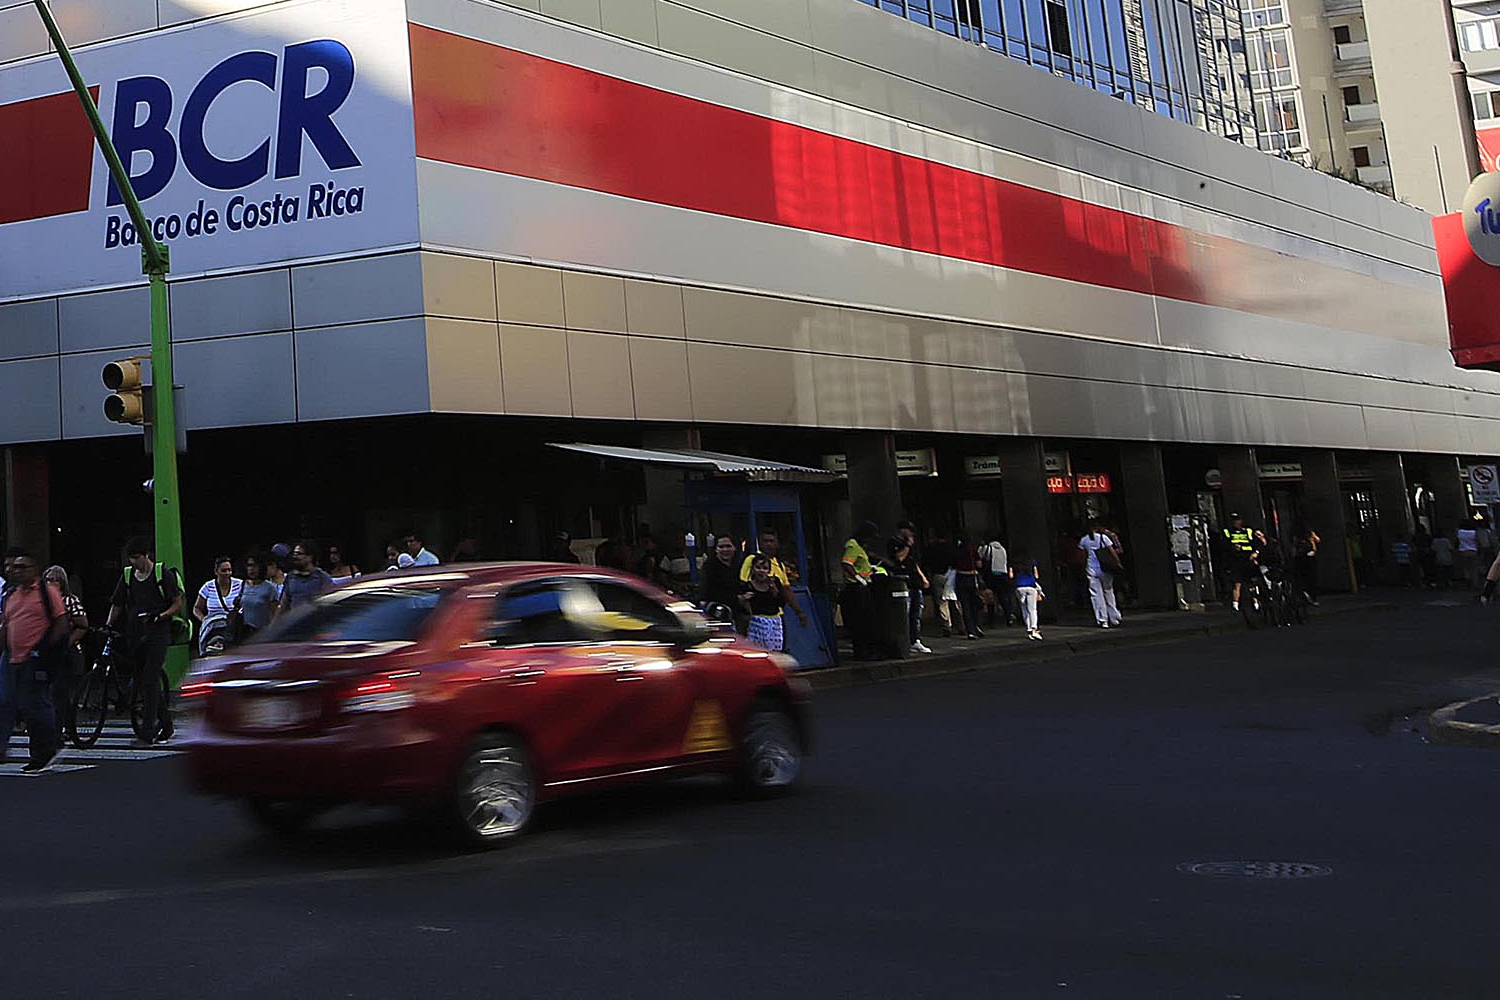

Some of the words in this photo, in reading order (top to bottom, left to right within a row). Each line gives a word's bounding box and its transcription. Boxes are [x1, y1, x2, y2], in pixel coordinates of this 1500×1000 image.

[106, 38, 363, 207] BCR
[186, 199, 218, 237] de
[226, 192, 300, 232] Costa
[307, 180, 365, 220] Rica
